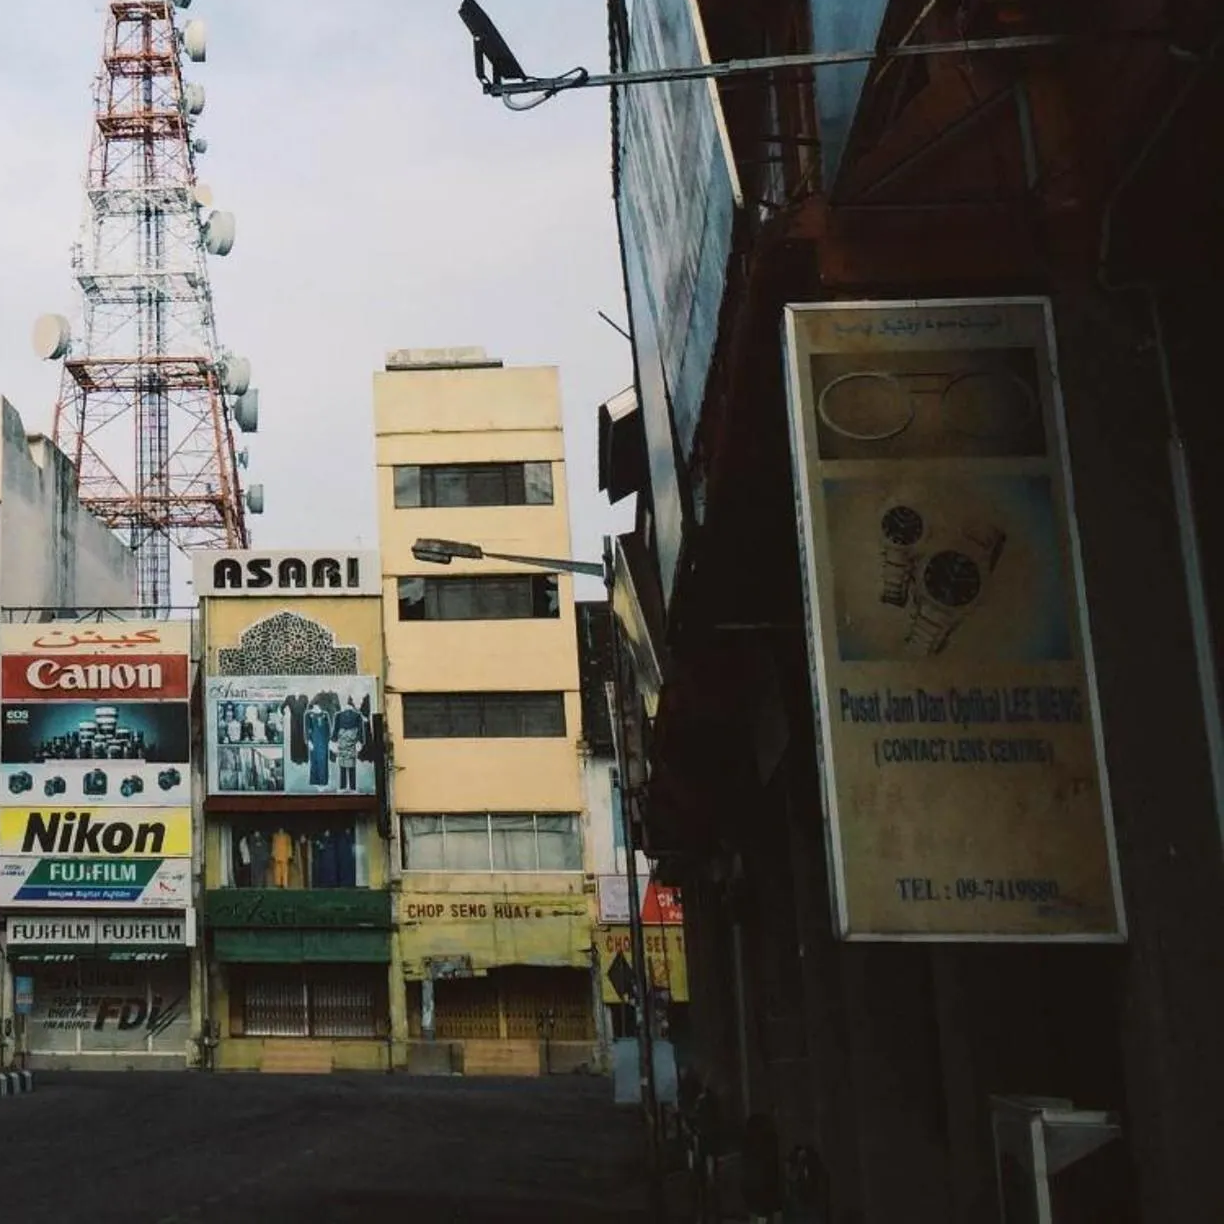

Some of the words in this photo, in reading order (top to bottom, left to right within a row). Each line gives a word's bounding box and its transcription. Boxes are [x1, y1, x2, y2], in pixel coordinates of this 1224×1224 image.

[213, 557, 359, 588] ASARI
[27, 659, 162, 690] Canon
[21, 811, 166, 854] Nikon
[49, 863, 137, 881] FUJIFILM
[896, 878, 940, 902] TEL
[407, 904, 445, 919] CHOP
[451, 903, 488, 919] SENG
[13, 925, 91, 940] FUJIFILM
[102, 925, 181, 940] FUJIFILM
